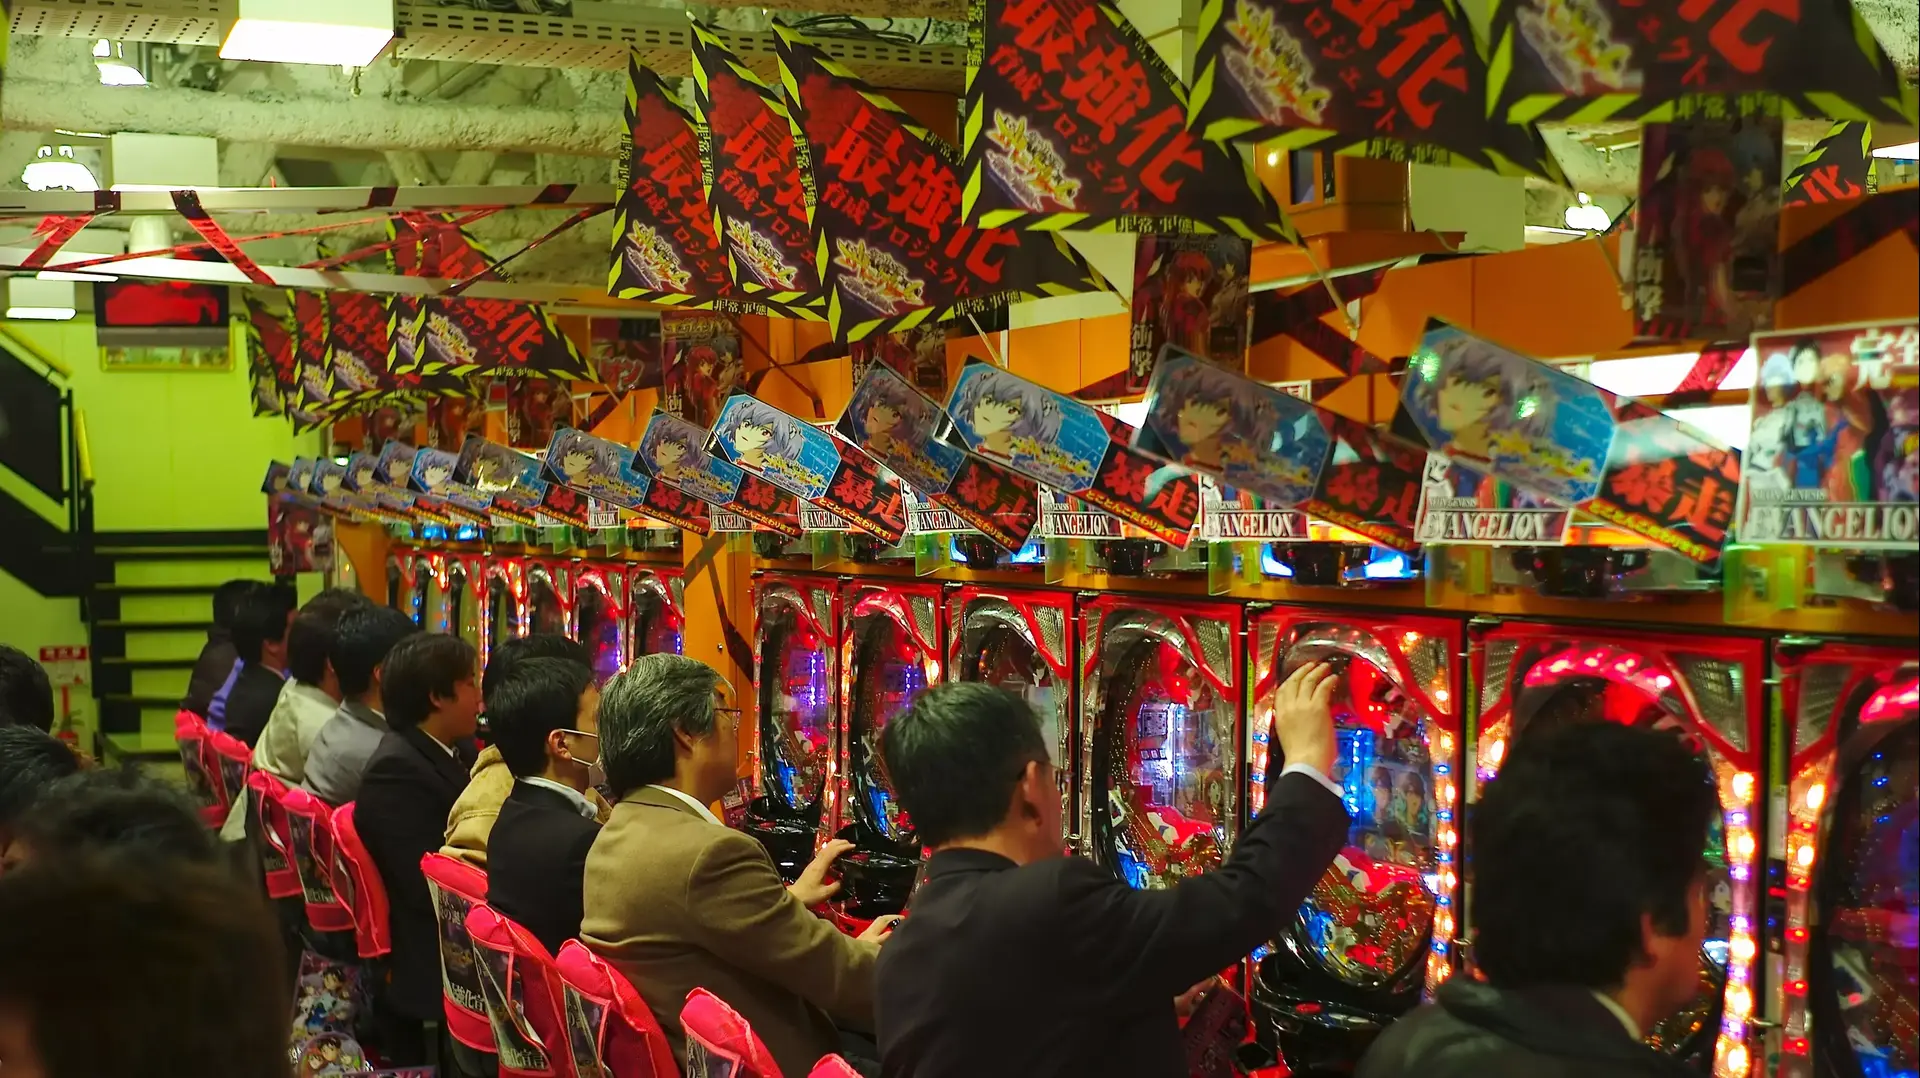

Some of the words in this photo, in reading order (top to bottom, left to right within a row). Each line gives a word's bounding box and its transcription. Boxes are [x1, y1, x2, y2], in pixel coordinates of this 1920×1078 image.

[824, 104, 1021, 284] 最強化
[822, 181, 971, 297] 育成プロジェクト
[1043, 514, 1110, 536] EVANGELION
[1204, 513, 1294, 537] EVANGELION
[1425, 512, 1547, 540] EVANGELION
[1746, 506, 1919, 541] EVANGELIO
